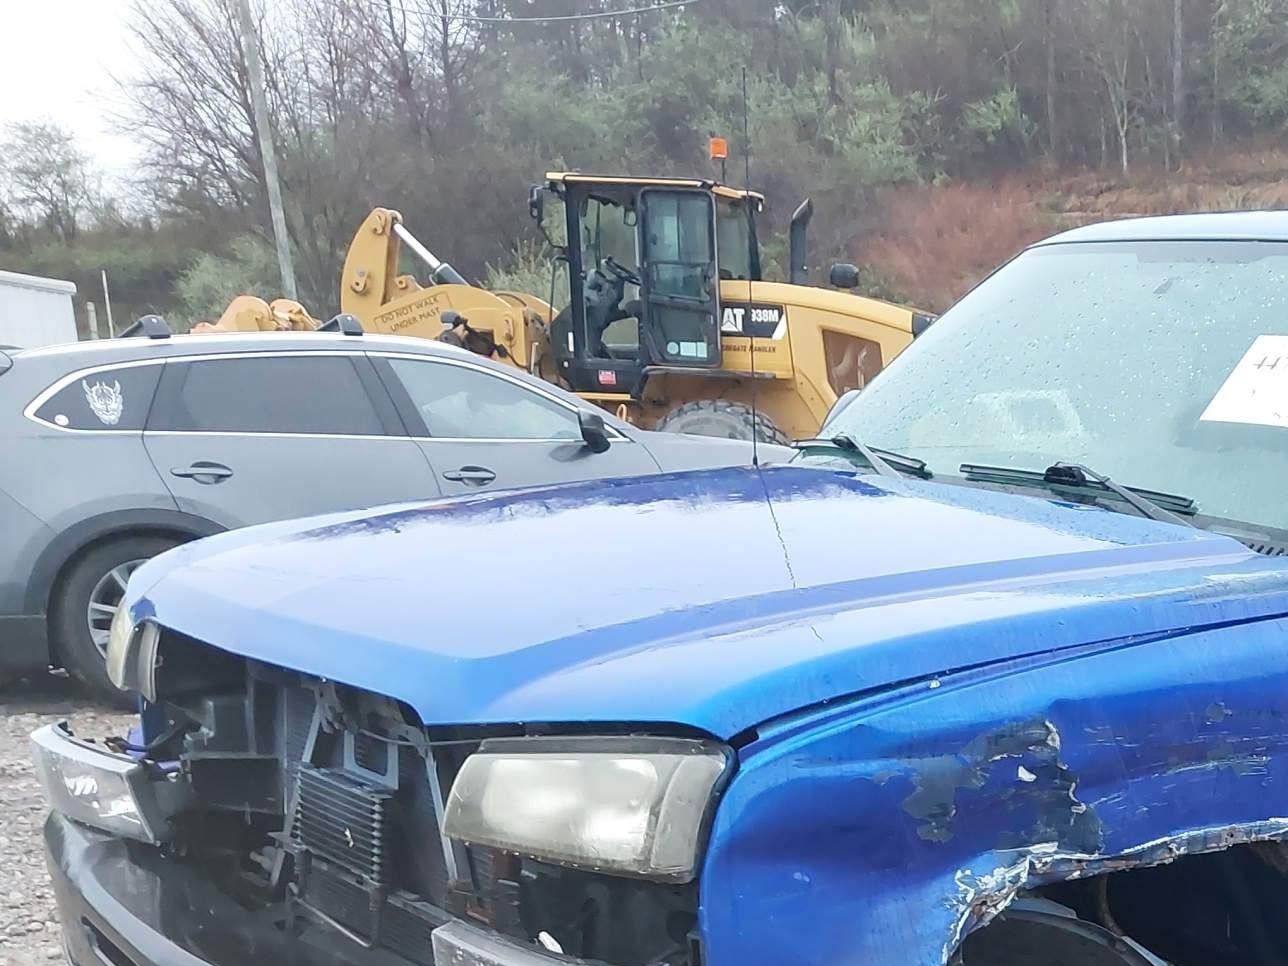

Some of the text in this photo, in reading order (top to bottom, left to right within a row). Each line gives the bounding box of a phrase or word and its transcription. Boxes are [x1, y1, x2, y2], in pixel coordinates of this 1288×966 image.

[381, 296, 439, 324] DO NOT WALK
[390, 306, 440, 332] UNDER MAST
[721, 308, 779, 332] AT 938M
